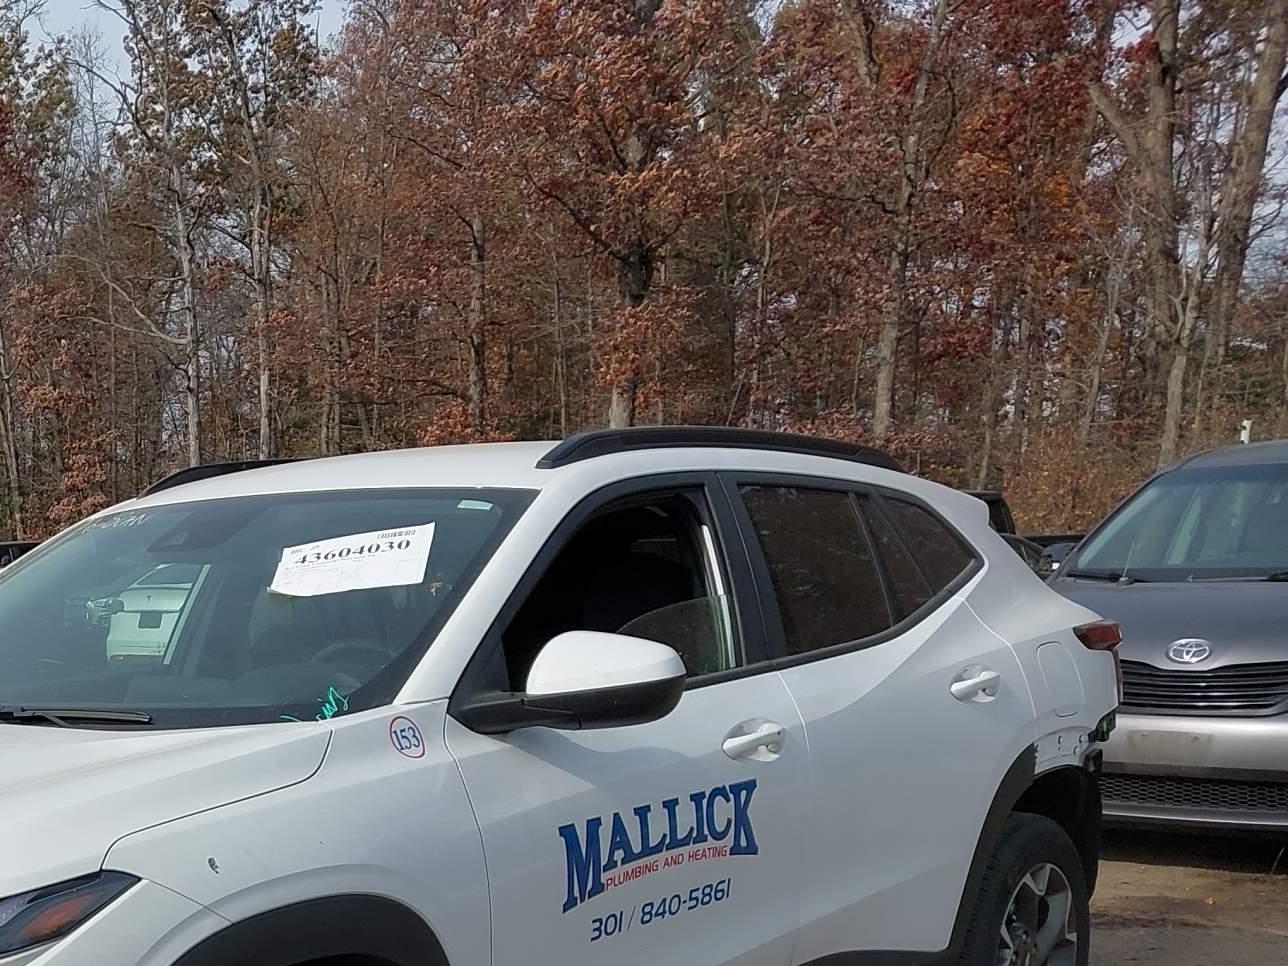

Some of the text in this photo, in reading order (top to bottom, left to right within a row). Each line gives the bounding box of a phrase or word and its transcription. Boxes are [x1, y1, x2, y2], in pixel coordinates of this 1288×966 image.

[293, 539, 412, 566] 43604030
[392, 726, 421, 751] 153
[558, 778, 760, 914] MALLICK
[605, 845, 728, 891] PLUMBING AND HEATING
[590, 911, 623, 942] 301
[640, 877, 732, 926] 840-5861
